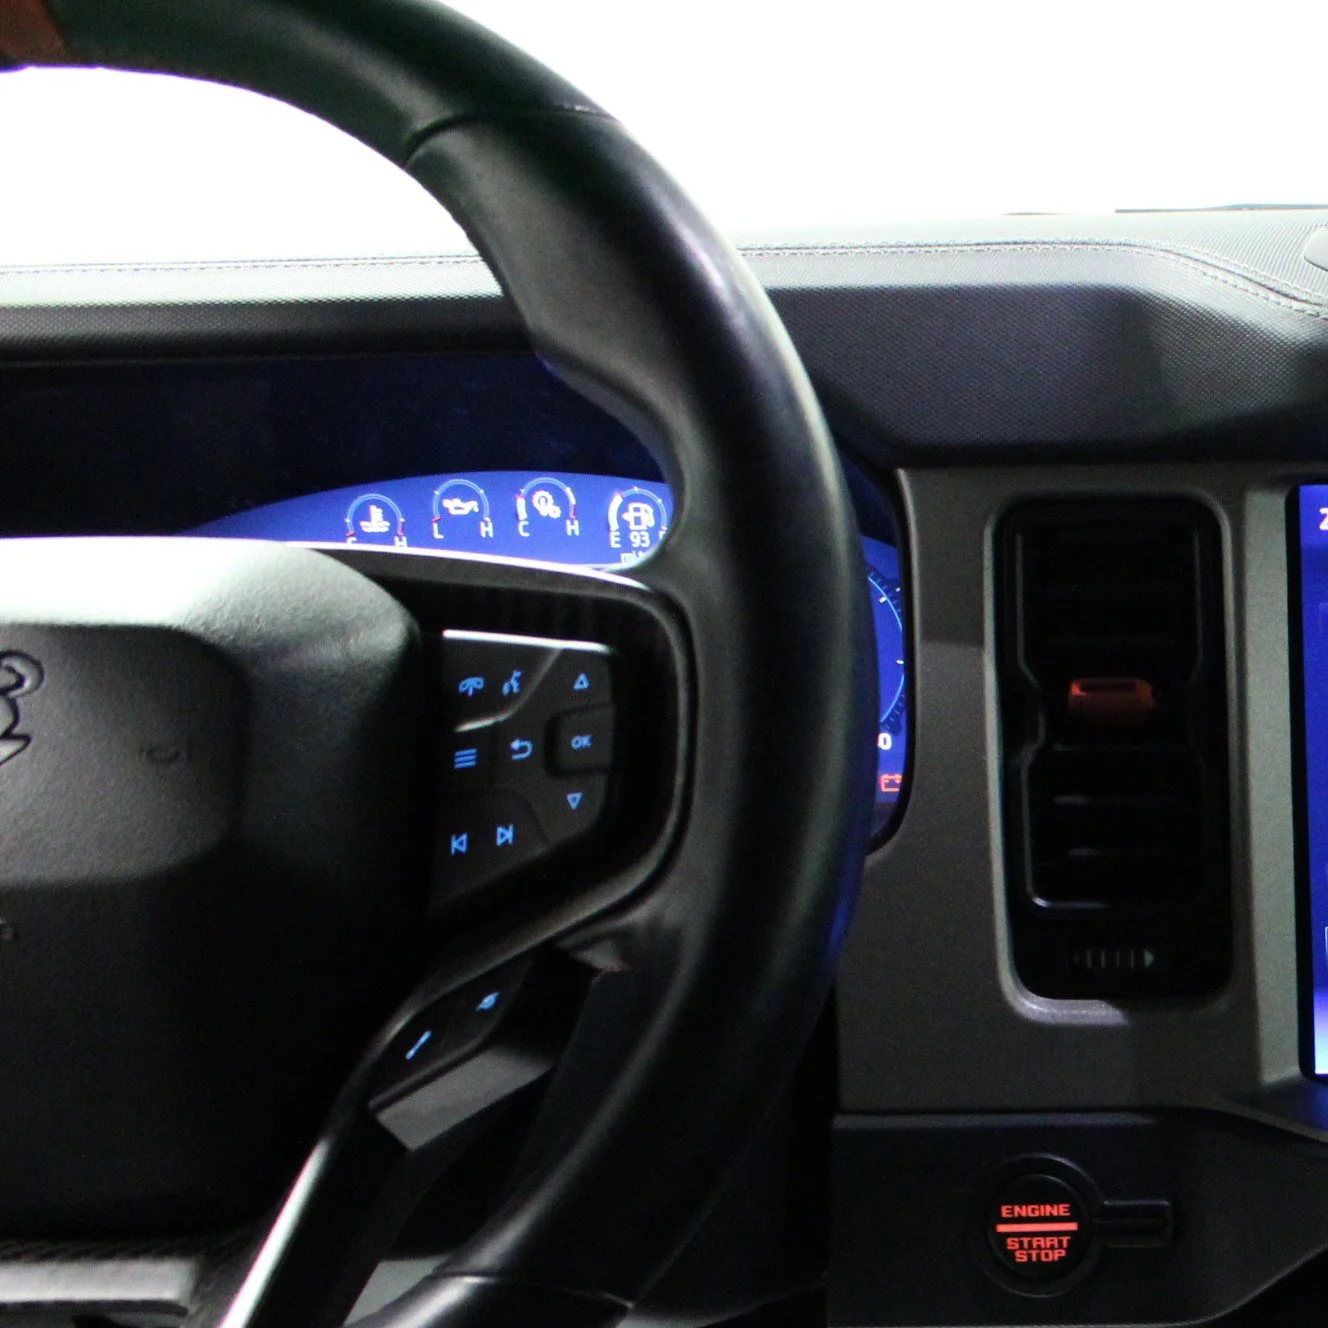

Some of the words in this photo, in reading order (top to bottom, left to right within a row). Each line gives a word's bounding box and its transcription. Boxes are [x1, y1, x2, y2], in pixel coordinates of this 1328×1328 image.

[433, 523, 444, 540] L
[480, 521, 494, 539] H
[518, 520, 530, 537] C
[566, 519, 580, 536] H
[610, 531, 621, 548] E
[630, 531, 650, 548] 93
[571, 734, 593, 750] OK
[1001, 1203, 1071, 1218] ENGINE
[1006, 1236, 1071, 1250] START
[1014, 1250, 1067, 1263] STOP
